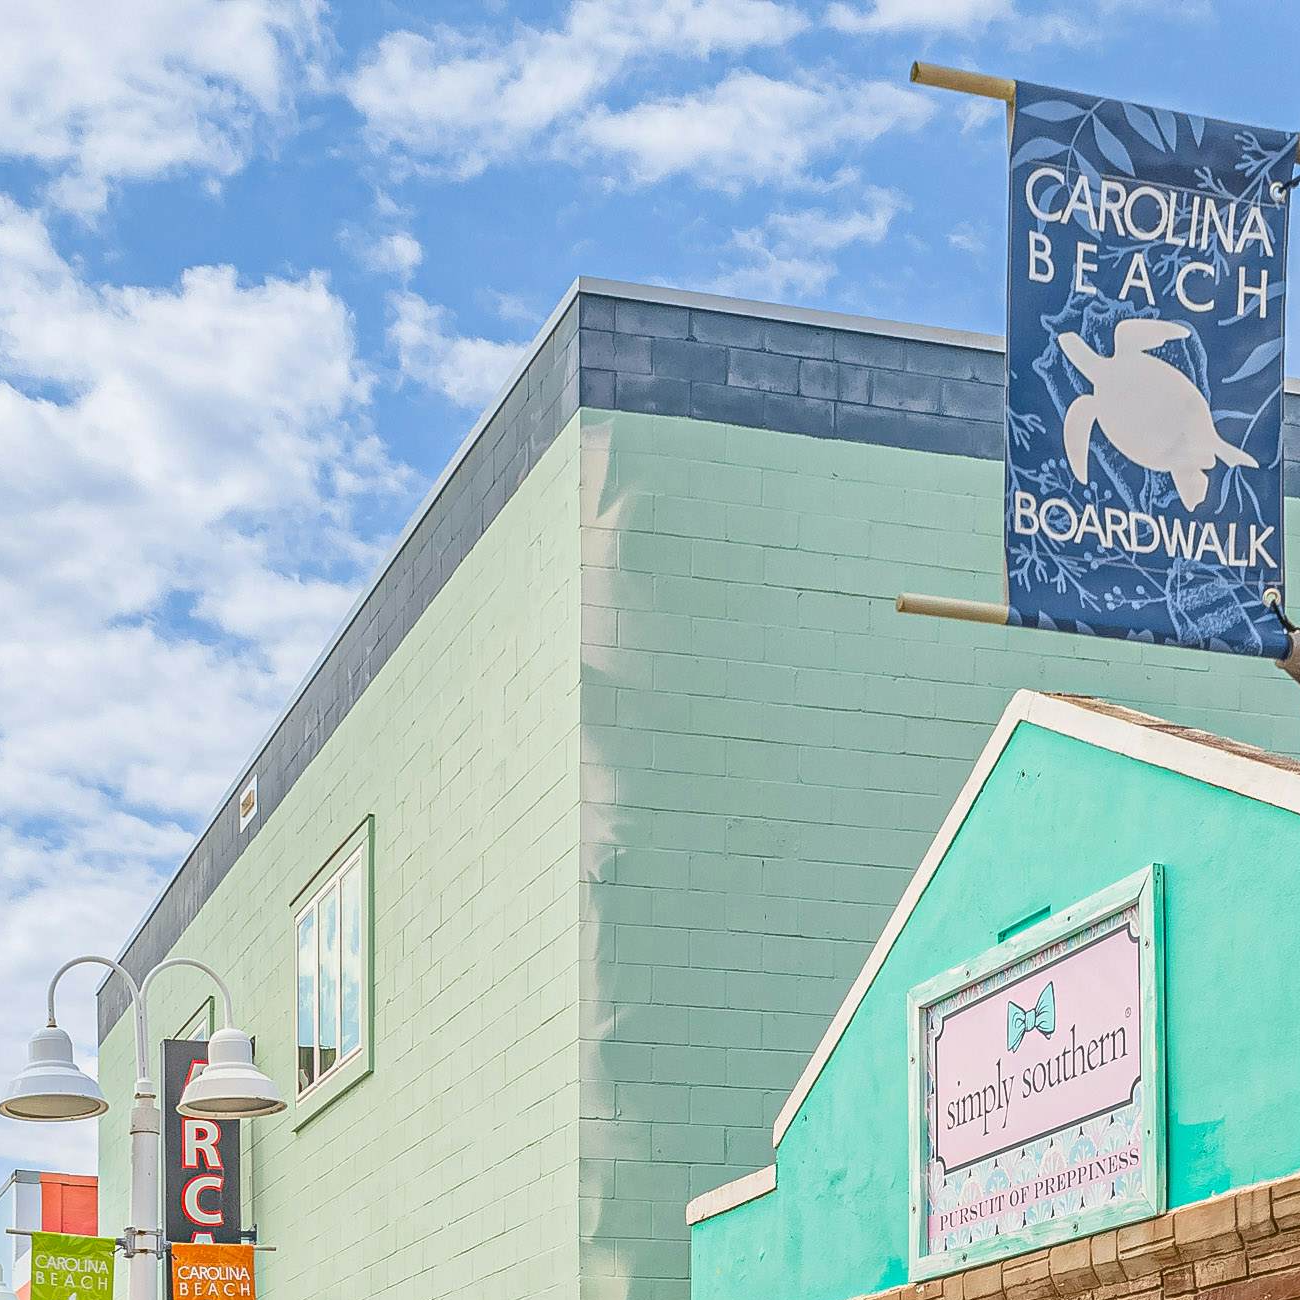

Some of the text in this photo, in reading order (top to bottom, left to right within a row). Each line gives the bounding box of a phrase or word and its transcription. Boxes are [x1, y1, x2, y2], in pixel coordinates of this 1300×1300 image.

[1025, 168, 1273, 257] CAROLINA
[1029, 231, 1268, 318] BEACH
[1014, 491, 1278, 569] BOARDWALK
[946, 1024, 1129, 1136] simply southern
[939, 1148, 1140, 1232] PURSUIT OF PREPPINESS
[35, 1254, 109, 1273] CAROLINA
[35, 1272, 108, 1291] BEACH
[177, 1266, 251, 1281] CAROLINA
[179, 1282, 251, 1297] BEACH
